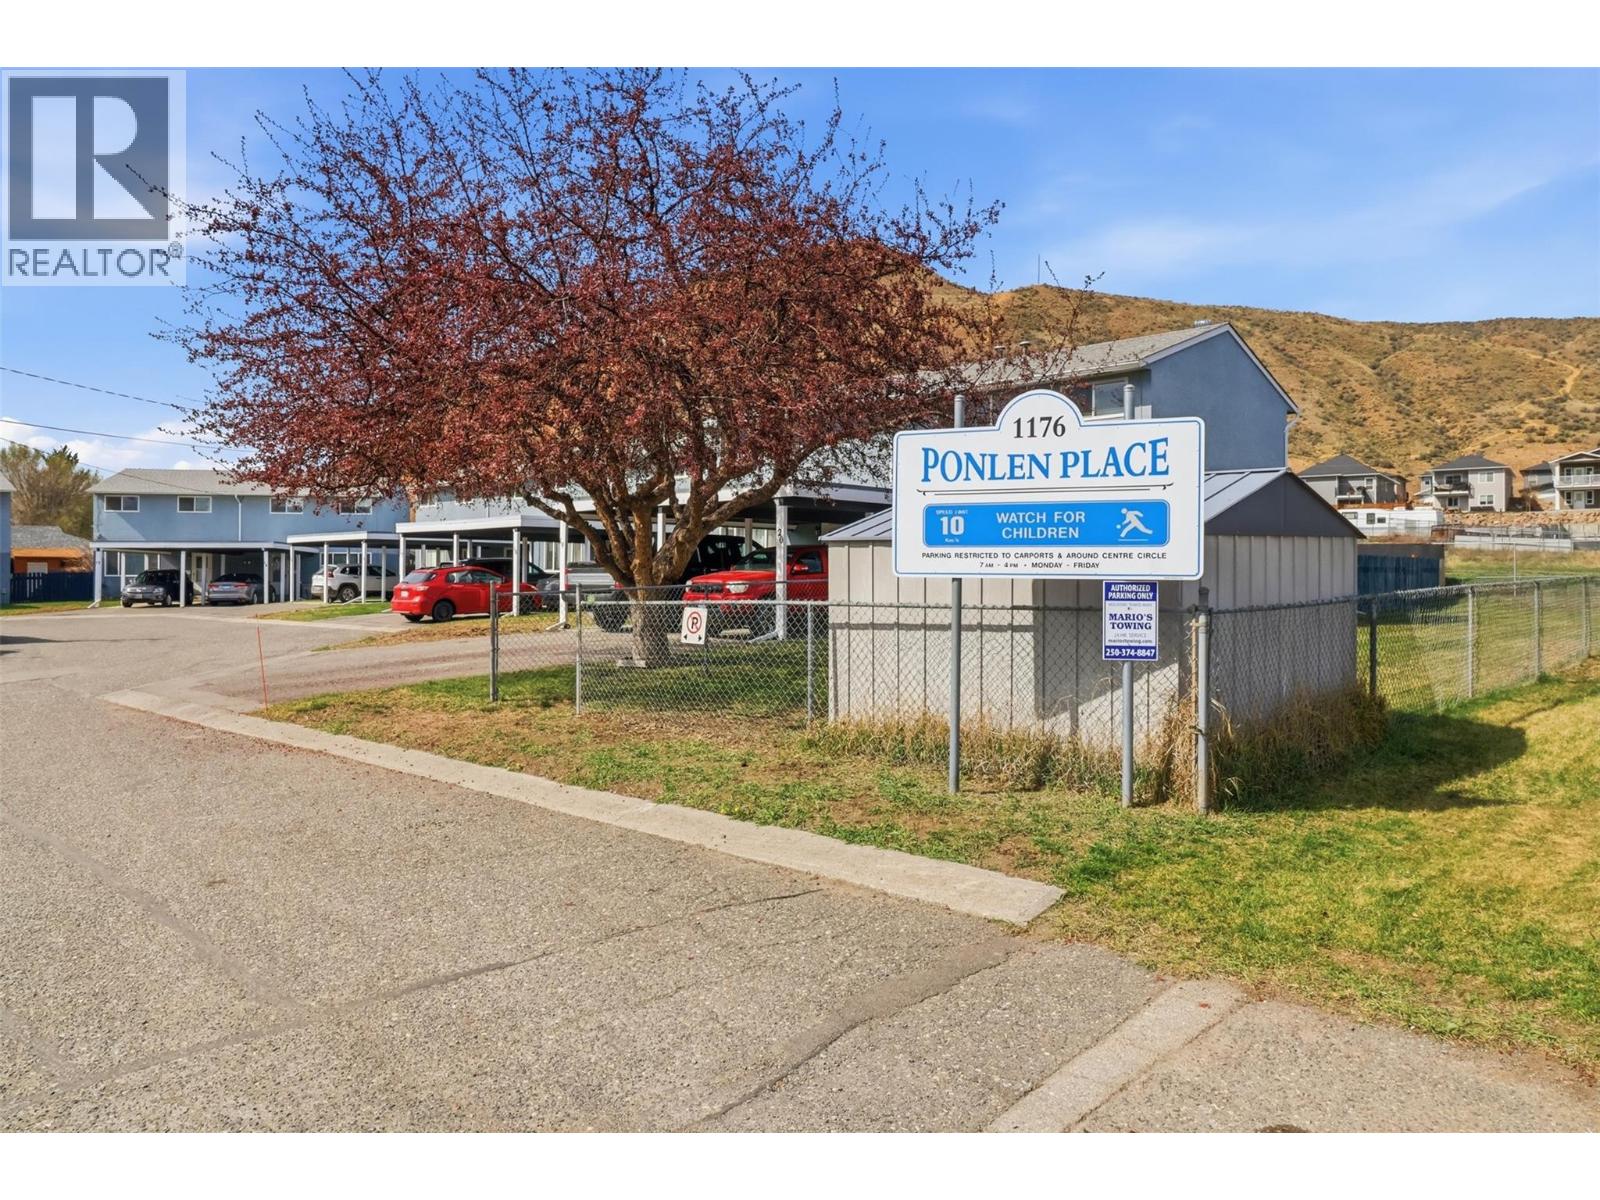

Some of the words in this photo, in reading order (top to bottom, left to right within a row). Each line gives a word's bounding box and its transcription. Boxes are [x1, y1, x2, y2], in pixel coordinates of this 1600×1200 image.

[1013, 415, 1066, 438] 1176
[921, 447, 1051, 482] PONLEN
[1060, 437, 1170, 478] PLACE
[996, 512, 1046, 524] WATCH
[1054, 511, 1086, 523] FOR
[940, 516, 965, 535] 10
[1001, 527, 1080, 540] CHILDREN
[1110, 584, 1151, 592] AUTHORIZED
[1108, 613, 1153, 621] MARIO'S
[1110, 622, 1152, 630] TOWING
[1105, 648, 1155, 657] 250-374-8847
